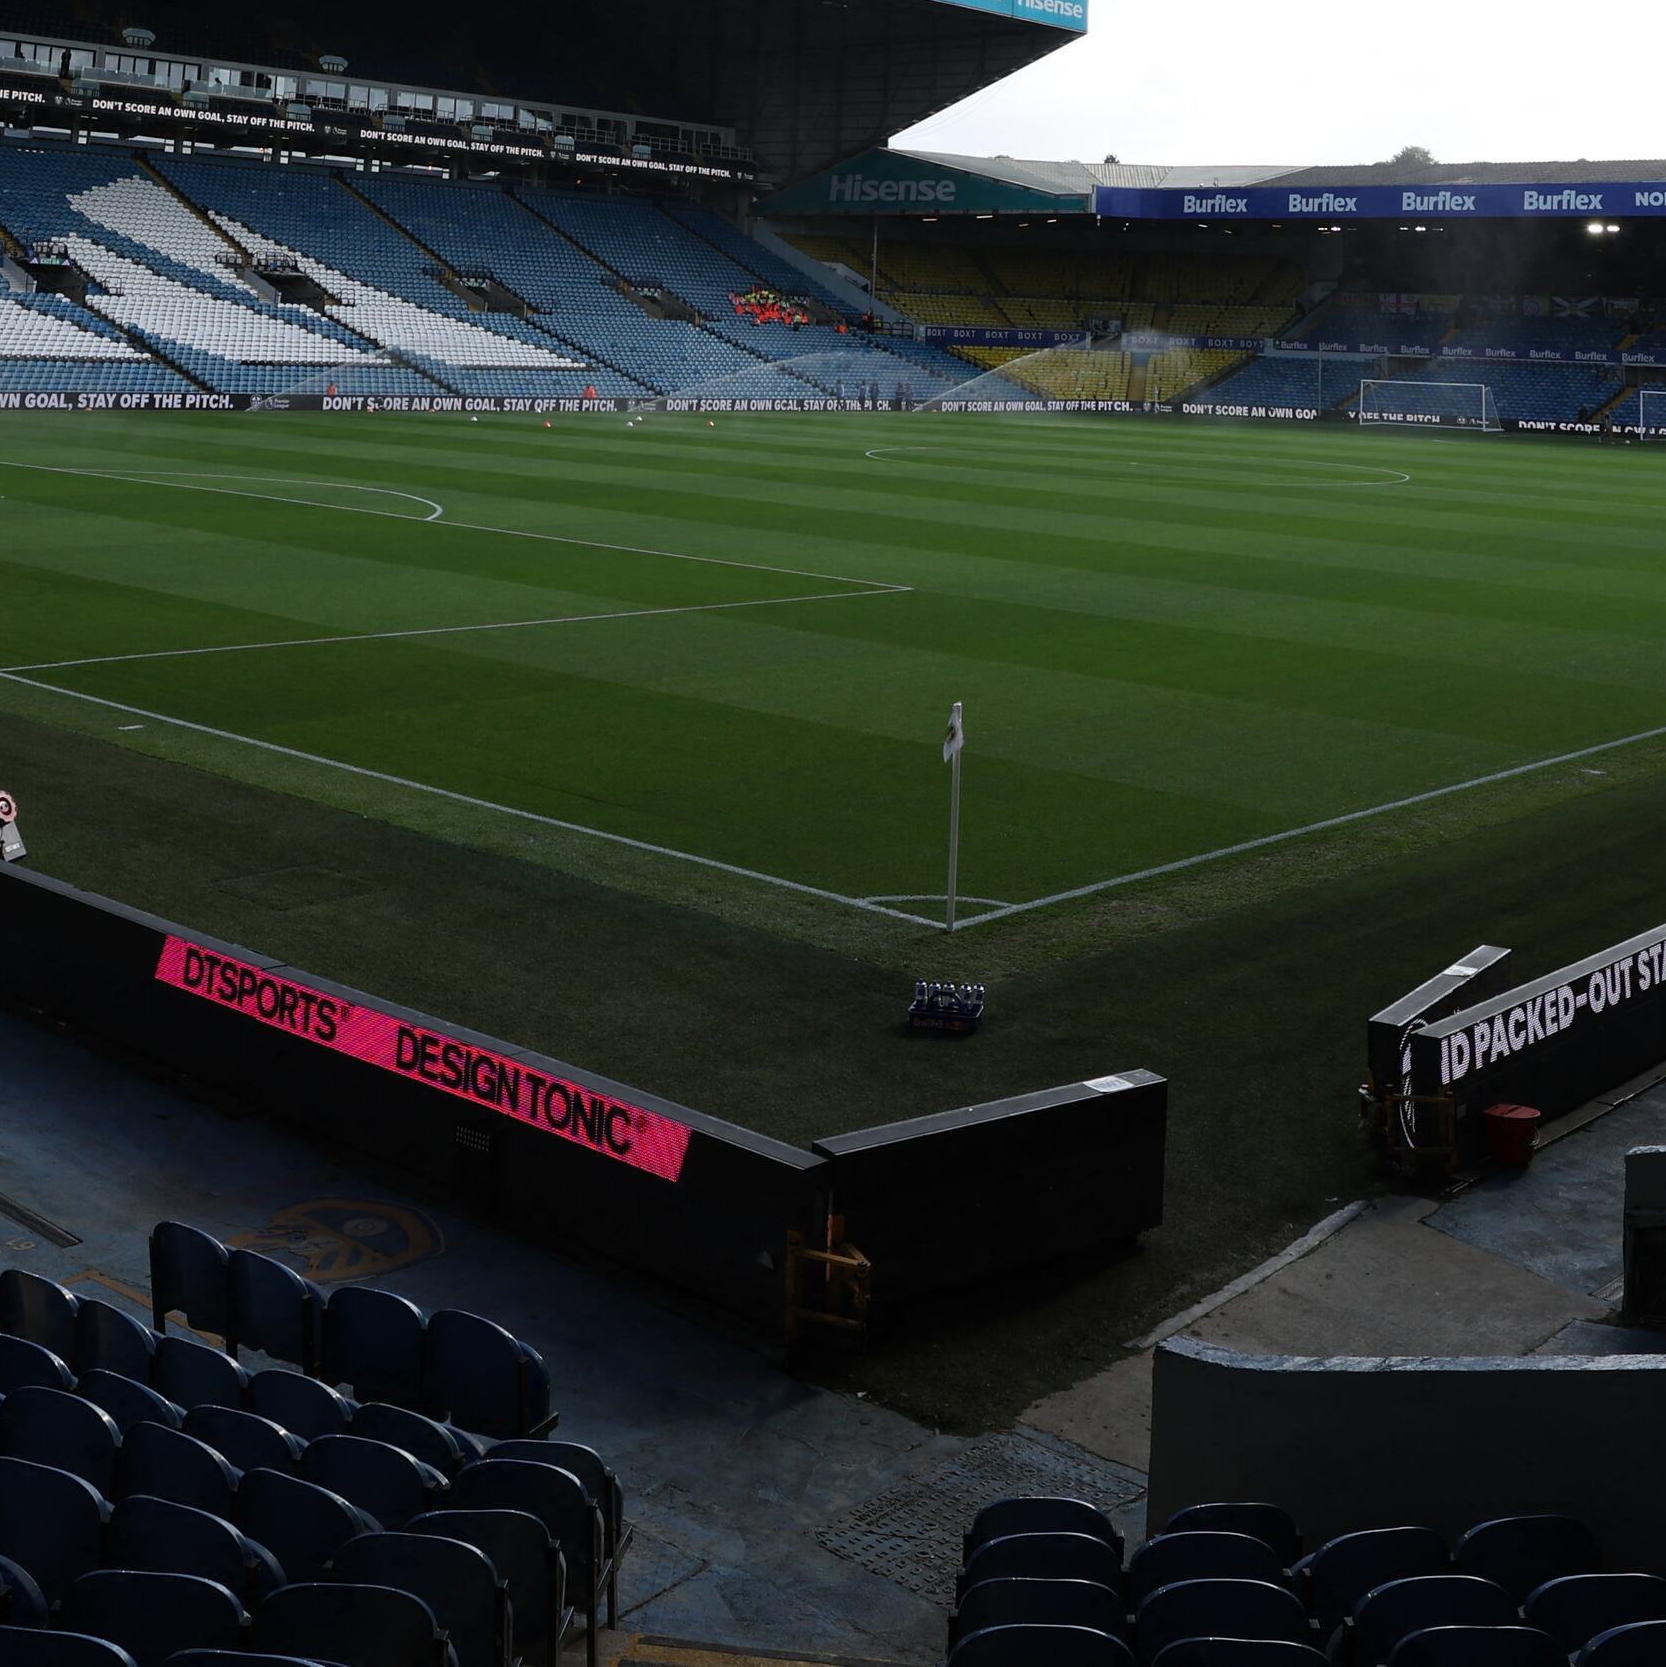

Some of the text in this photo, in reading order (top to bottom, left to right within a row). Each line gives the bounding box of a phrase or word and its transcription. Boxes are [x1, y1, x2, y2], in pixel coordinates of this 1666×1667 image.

[12, 91, 45, 102] PITCH.
[830, 174, 956, 202] Hisense
[1184, 190, 1602, 212] Burflex Burflex Burflex Burflex
[953, 327, 975, 337] BOXT
[984, 328, 1008, 338] BOXT
[1017, 329, 1042, 340] BOXT
[1055, 334, 1083, 344] BOXT
[1131, 335, 1265, 350] BOXT BOXT BOXT BOXT
[1280, 341, 1310, 352] Burflex
[1360, 344, 1390, 355] Burflex
[1401, 345, 1429, 356] Burflex
[1441, 347, 1474, 358] Burflex
[1485, 348, 1517, 360] Burflex
[1575, 352, 1607, 362] Burflex
[25, 391, 75, 410] GOAL,
[77, 391, 116, 411] STAY
[120, 394, 149, 407] OFF
[154, 392, 184, 408] THE
[186, 392, 235, 408] PITCH.
[323, 397, 364, 410] DON'T
[412, 398, 430, 410] AN
[432, 398, 462, 412] OWN
[465, 398, 499, 411] GOAL,
[504, 399, 532, 411] STAY
[535, 399, 556, 413] OFF
[559, 400, 579, 411] THE
[582, 400, 617, 411] PITCH.
[1473, 956, 1633, 1070] PACKED-OUT
